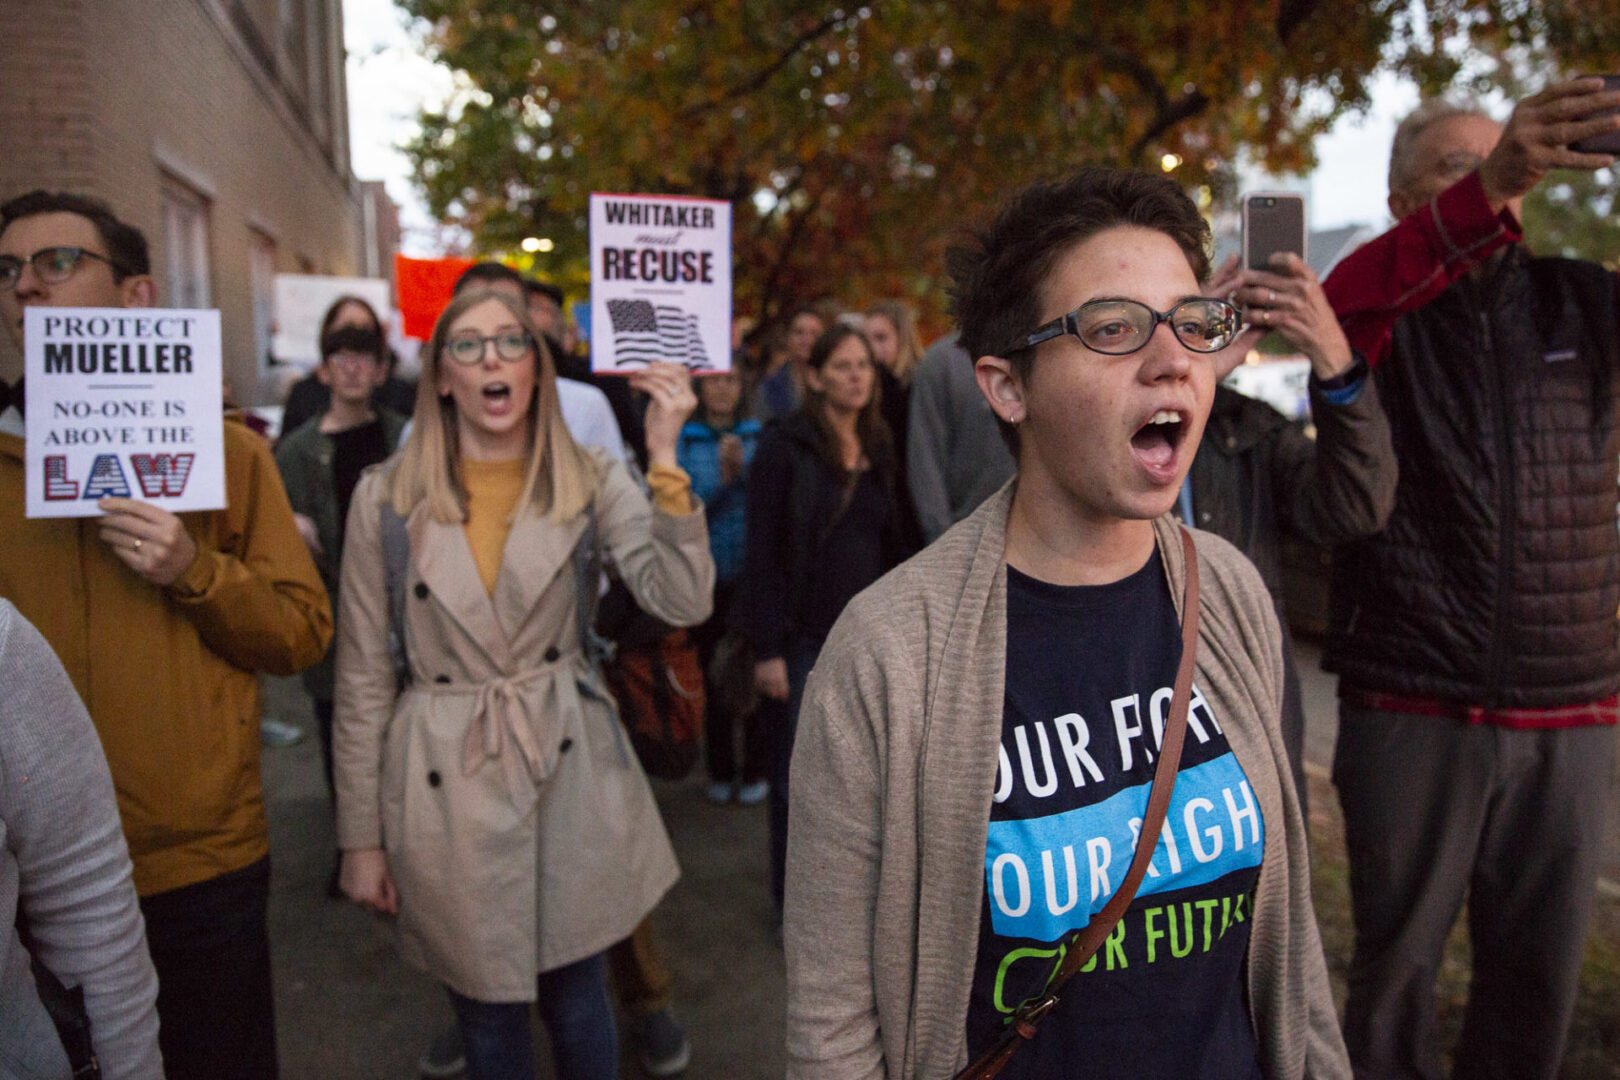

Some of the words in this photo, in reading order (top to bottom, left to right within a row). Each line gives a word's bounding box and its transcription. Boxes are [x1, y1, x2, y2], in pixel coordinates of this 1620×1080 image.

[605, 201, 715, 229] WHITAKER
[634, 231, 684, 246] must
[602, 247, 714, 284] RECUSE
[44, 316, 196, 338] PROTECT
[44, 343, 194, 374] MUELLER
[53, 401, 157, 419] NO-ONE
[164, 401, 187, 417] IS
[44, 427, 136, 446] ABOVE
[142, 426, 195, 444] THE
[43, 453, 196, 501] LAW
[992, 836, 1111, 918] OUR
